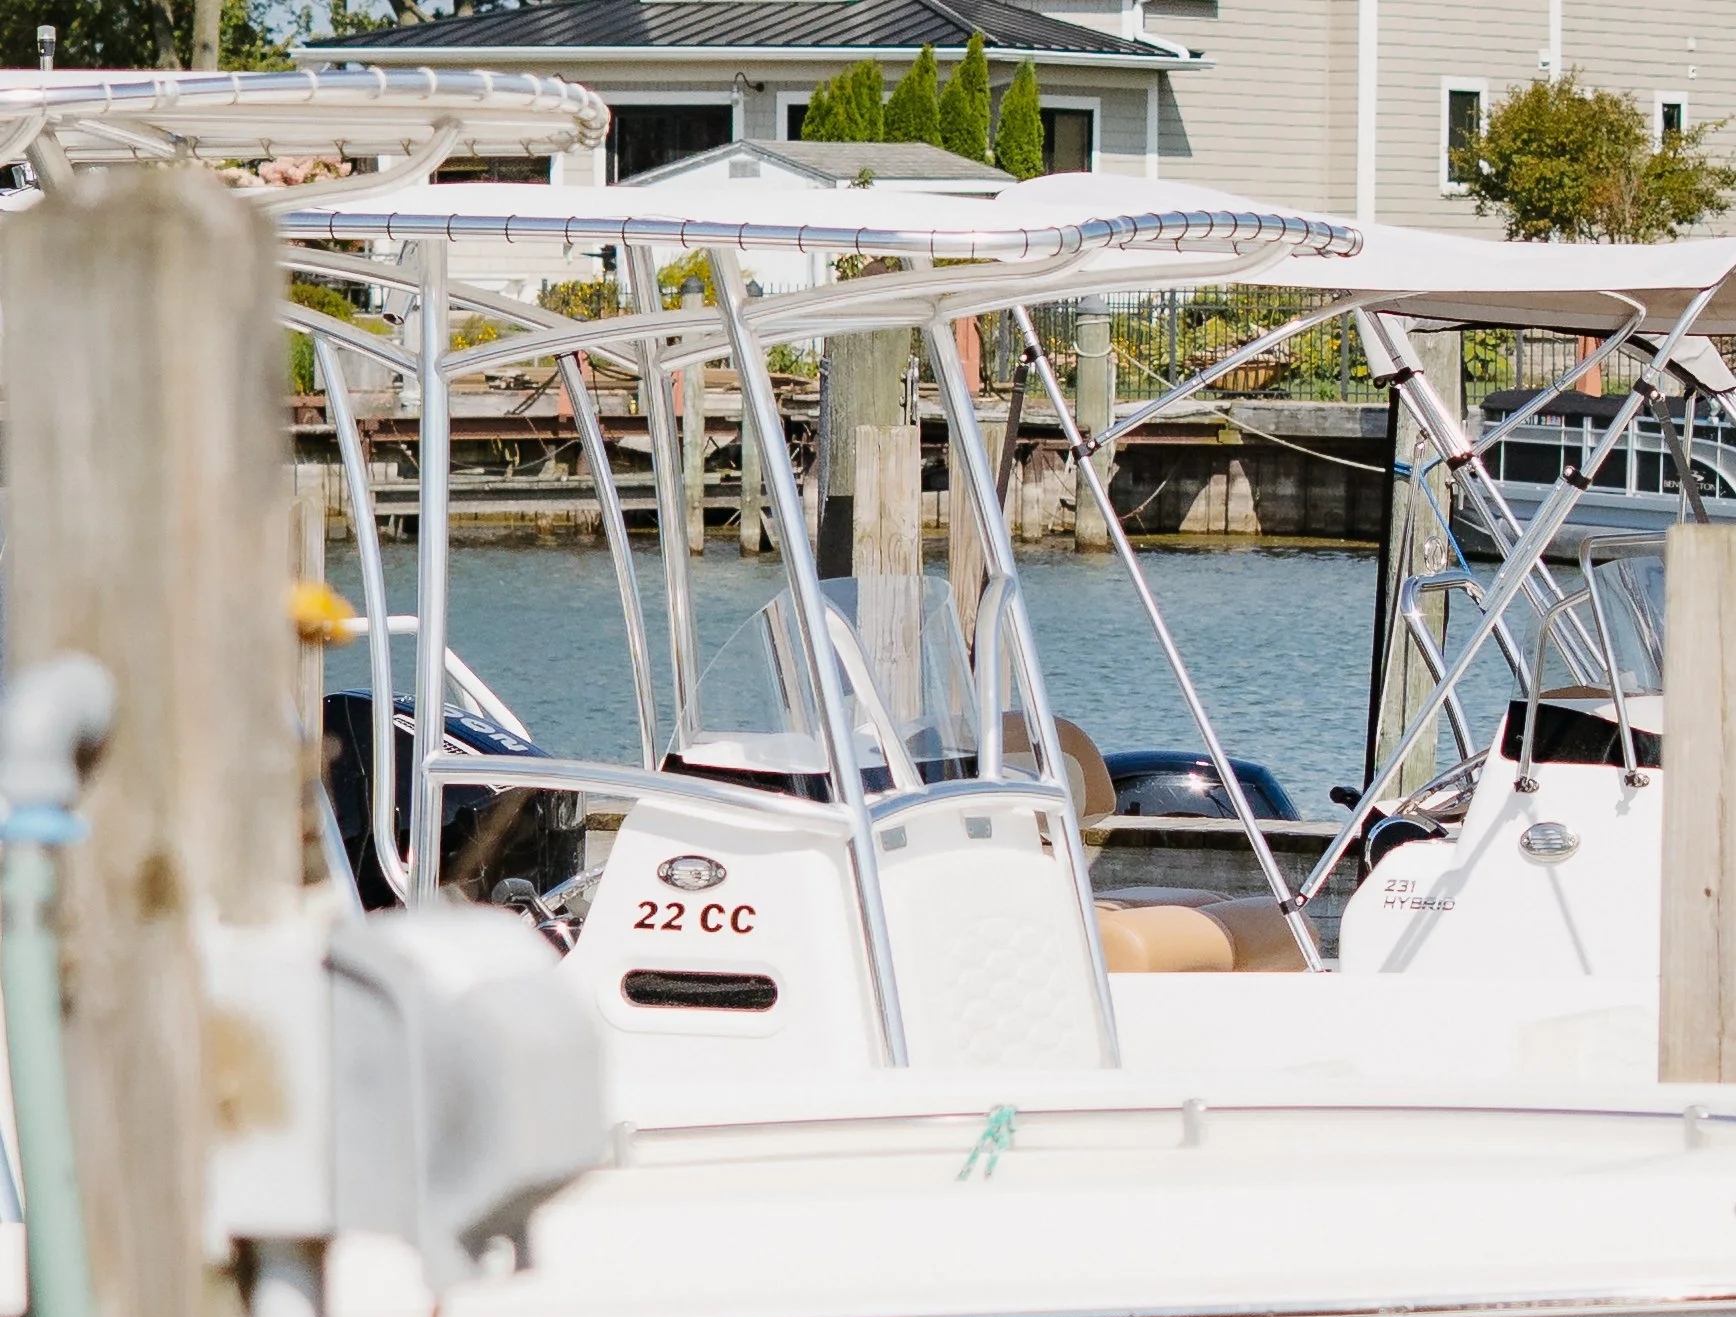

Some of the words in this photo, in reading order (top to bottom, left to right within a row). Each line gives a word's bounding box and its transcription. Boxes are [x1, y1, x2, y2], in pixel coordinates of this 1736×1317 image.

[1384, 879, 1416, 893] 231
[1383, 895, 1456, 911] HYBRID
[633, 900, 686, 932] 22
[700, 903, 757, 935] CC
